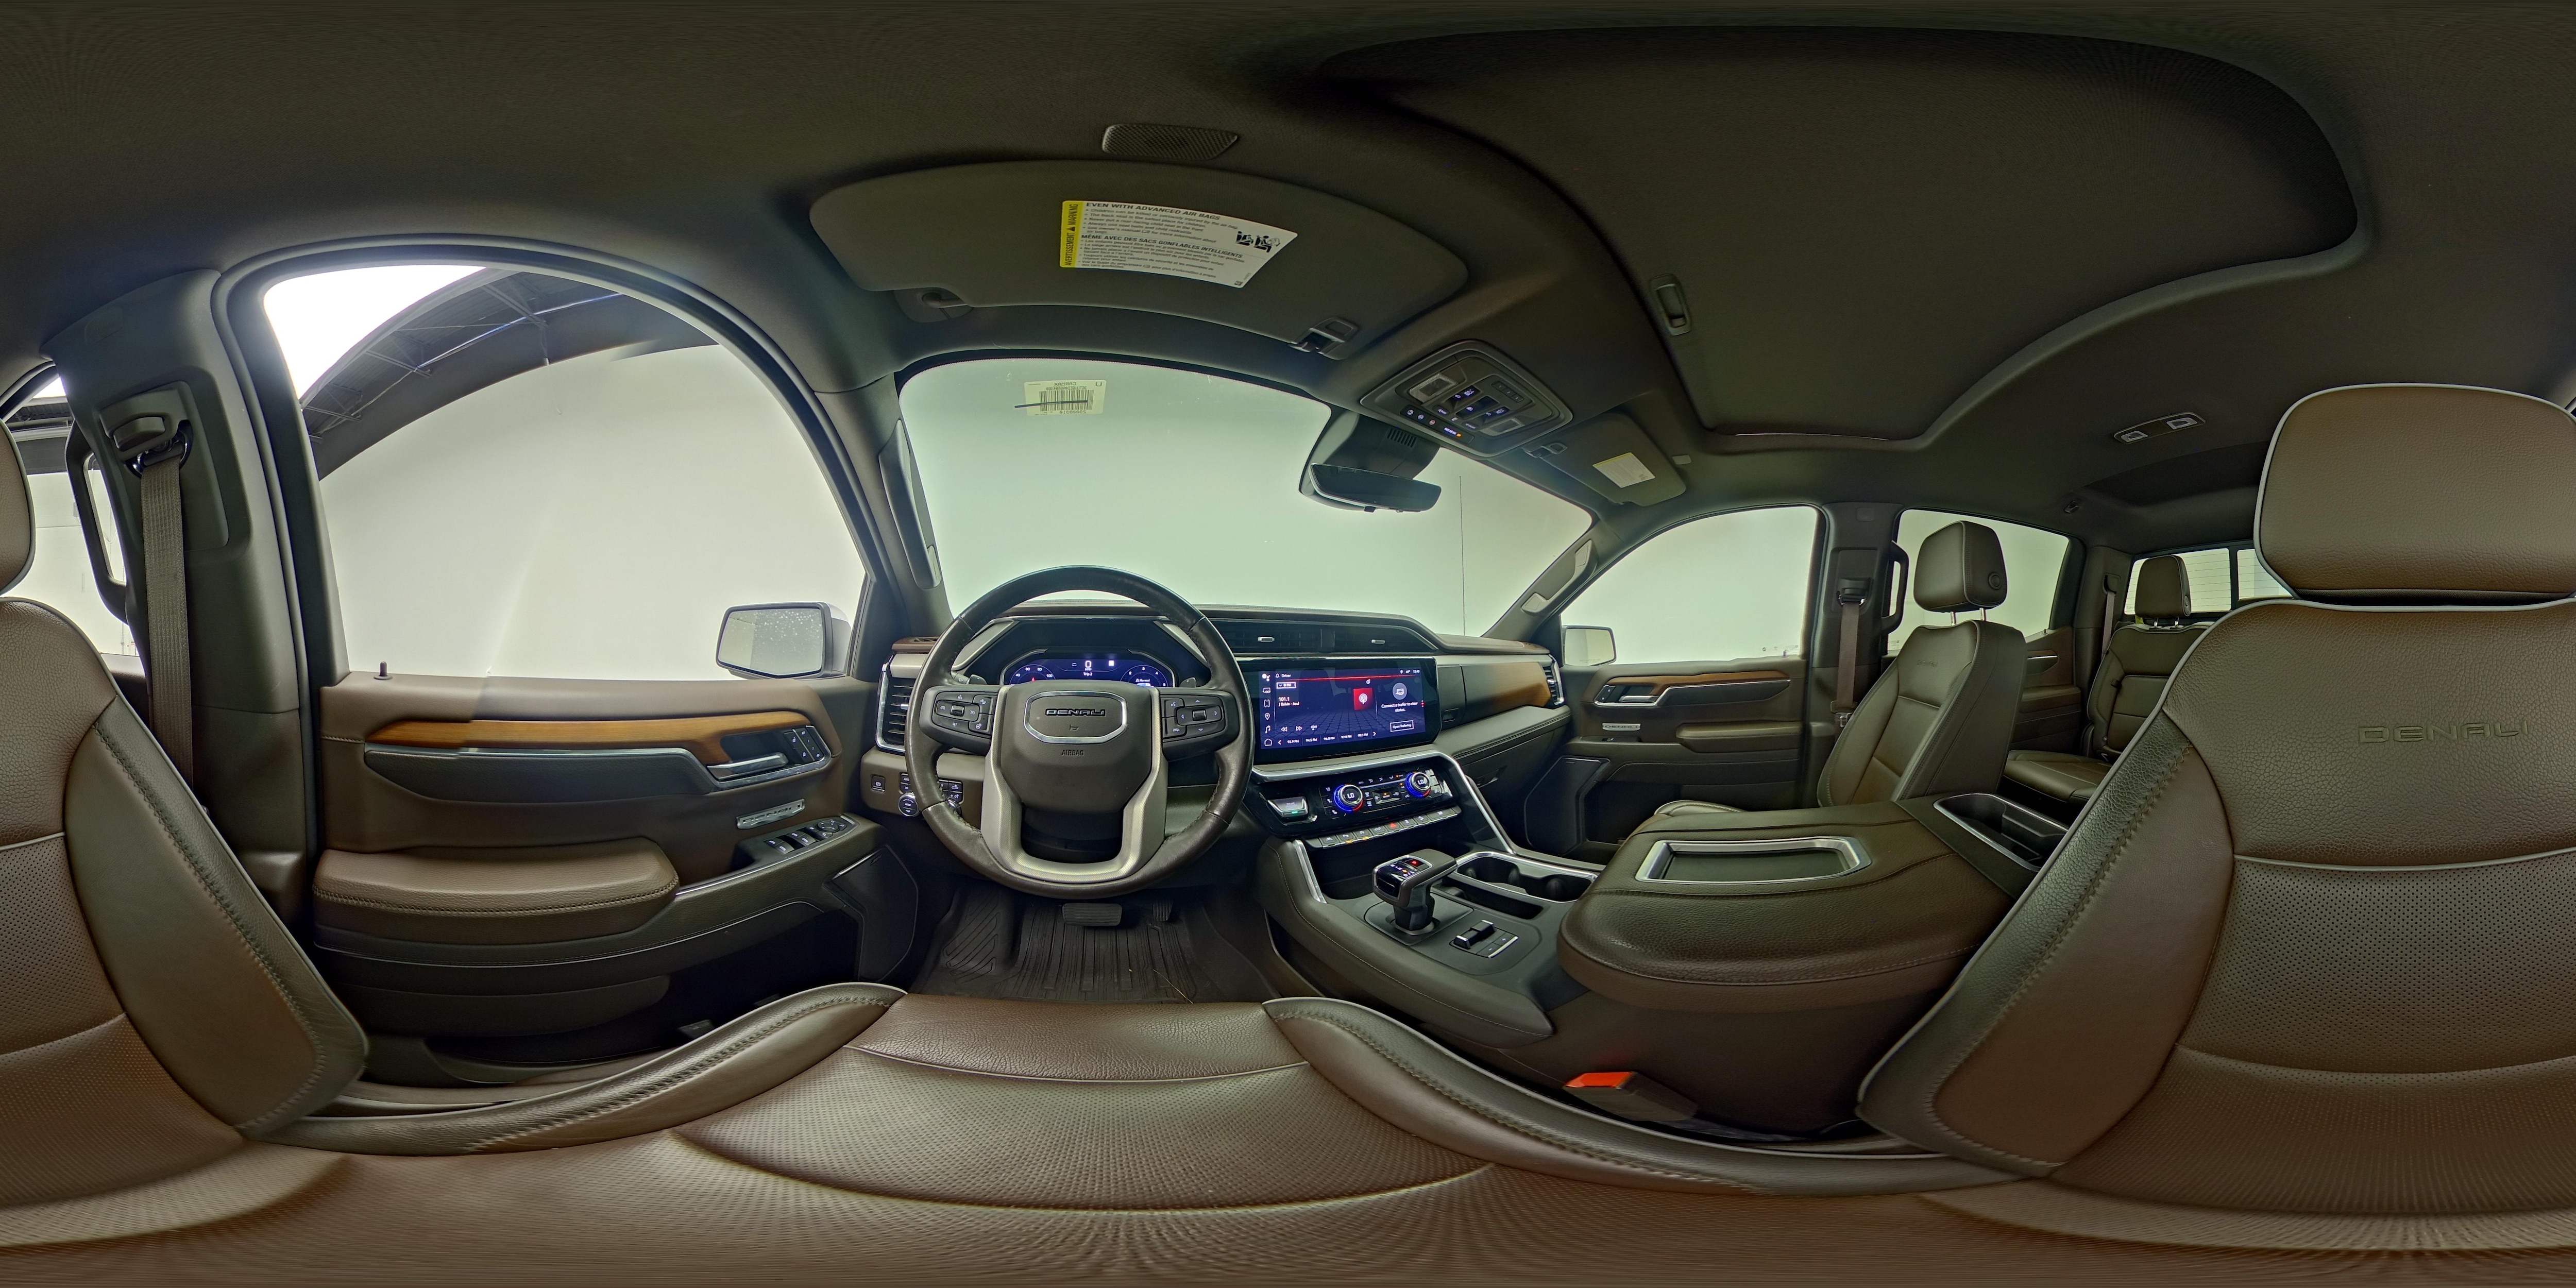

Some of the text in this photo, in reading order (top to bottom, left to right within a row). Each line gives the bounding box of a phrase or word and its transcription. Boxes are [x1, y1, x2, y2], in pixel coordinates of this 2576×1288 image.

[1065, 204, 1078, 266] AVERTISSEMENT WARNING
[1159, 241, 1200, 249] GONFLABLES
[1201, 247, 1243, 258] INTELLIGENTS
[2358, 720, 2529, 743] DENALI
